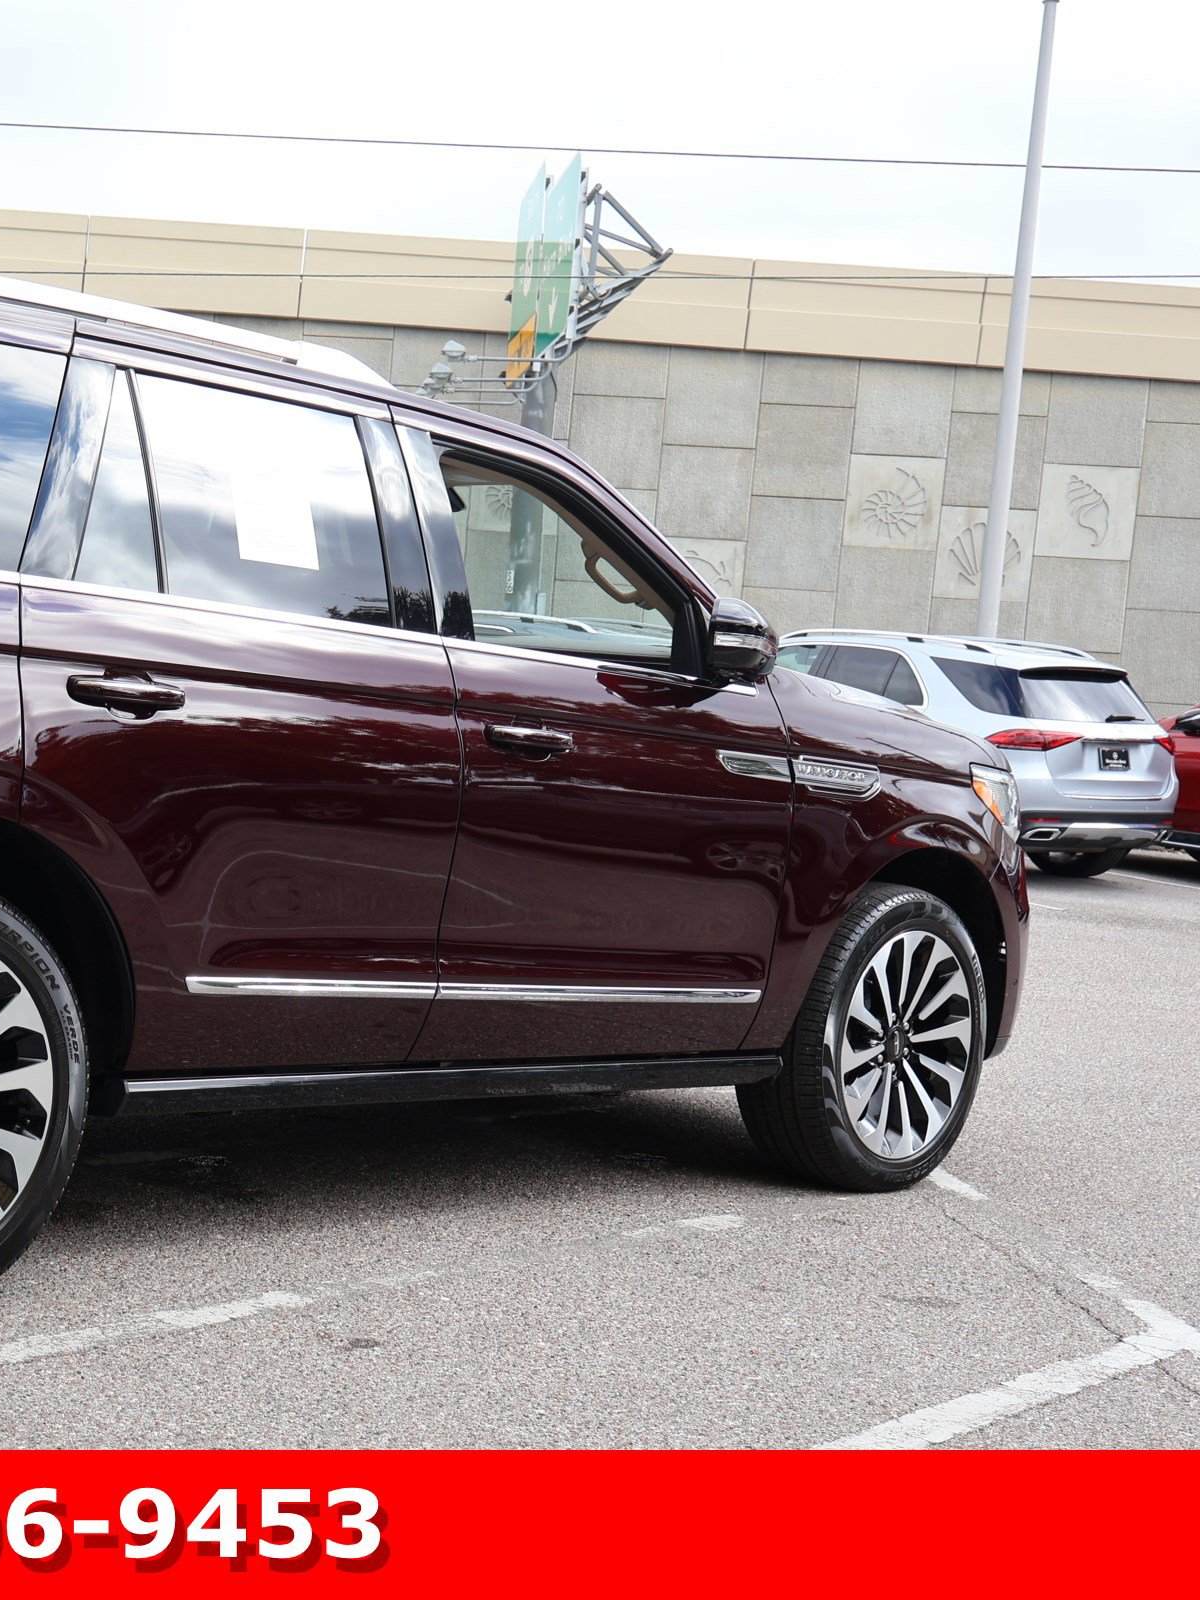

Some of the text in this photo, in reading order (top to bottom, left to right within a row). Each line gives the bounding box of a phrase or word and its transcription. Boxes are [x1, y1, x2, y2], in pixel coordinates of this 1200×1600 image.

[798, 764, 866, 781] NAVIGATOR
[60, 1010, 74, 1060] ALL SEASON
[62, 1003, 81, 1065] VERDE
